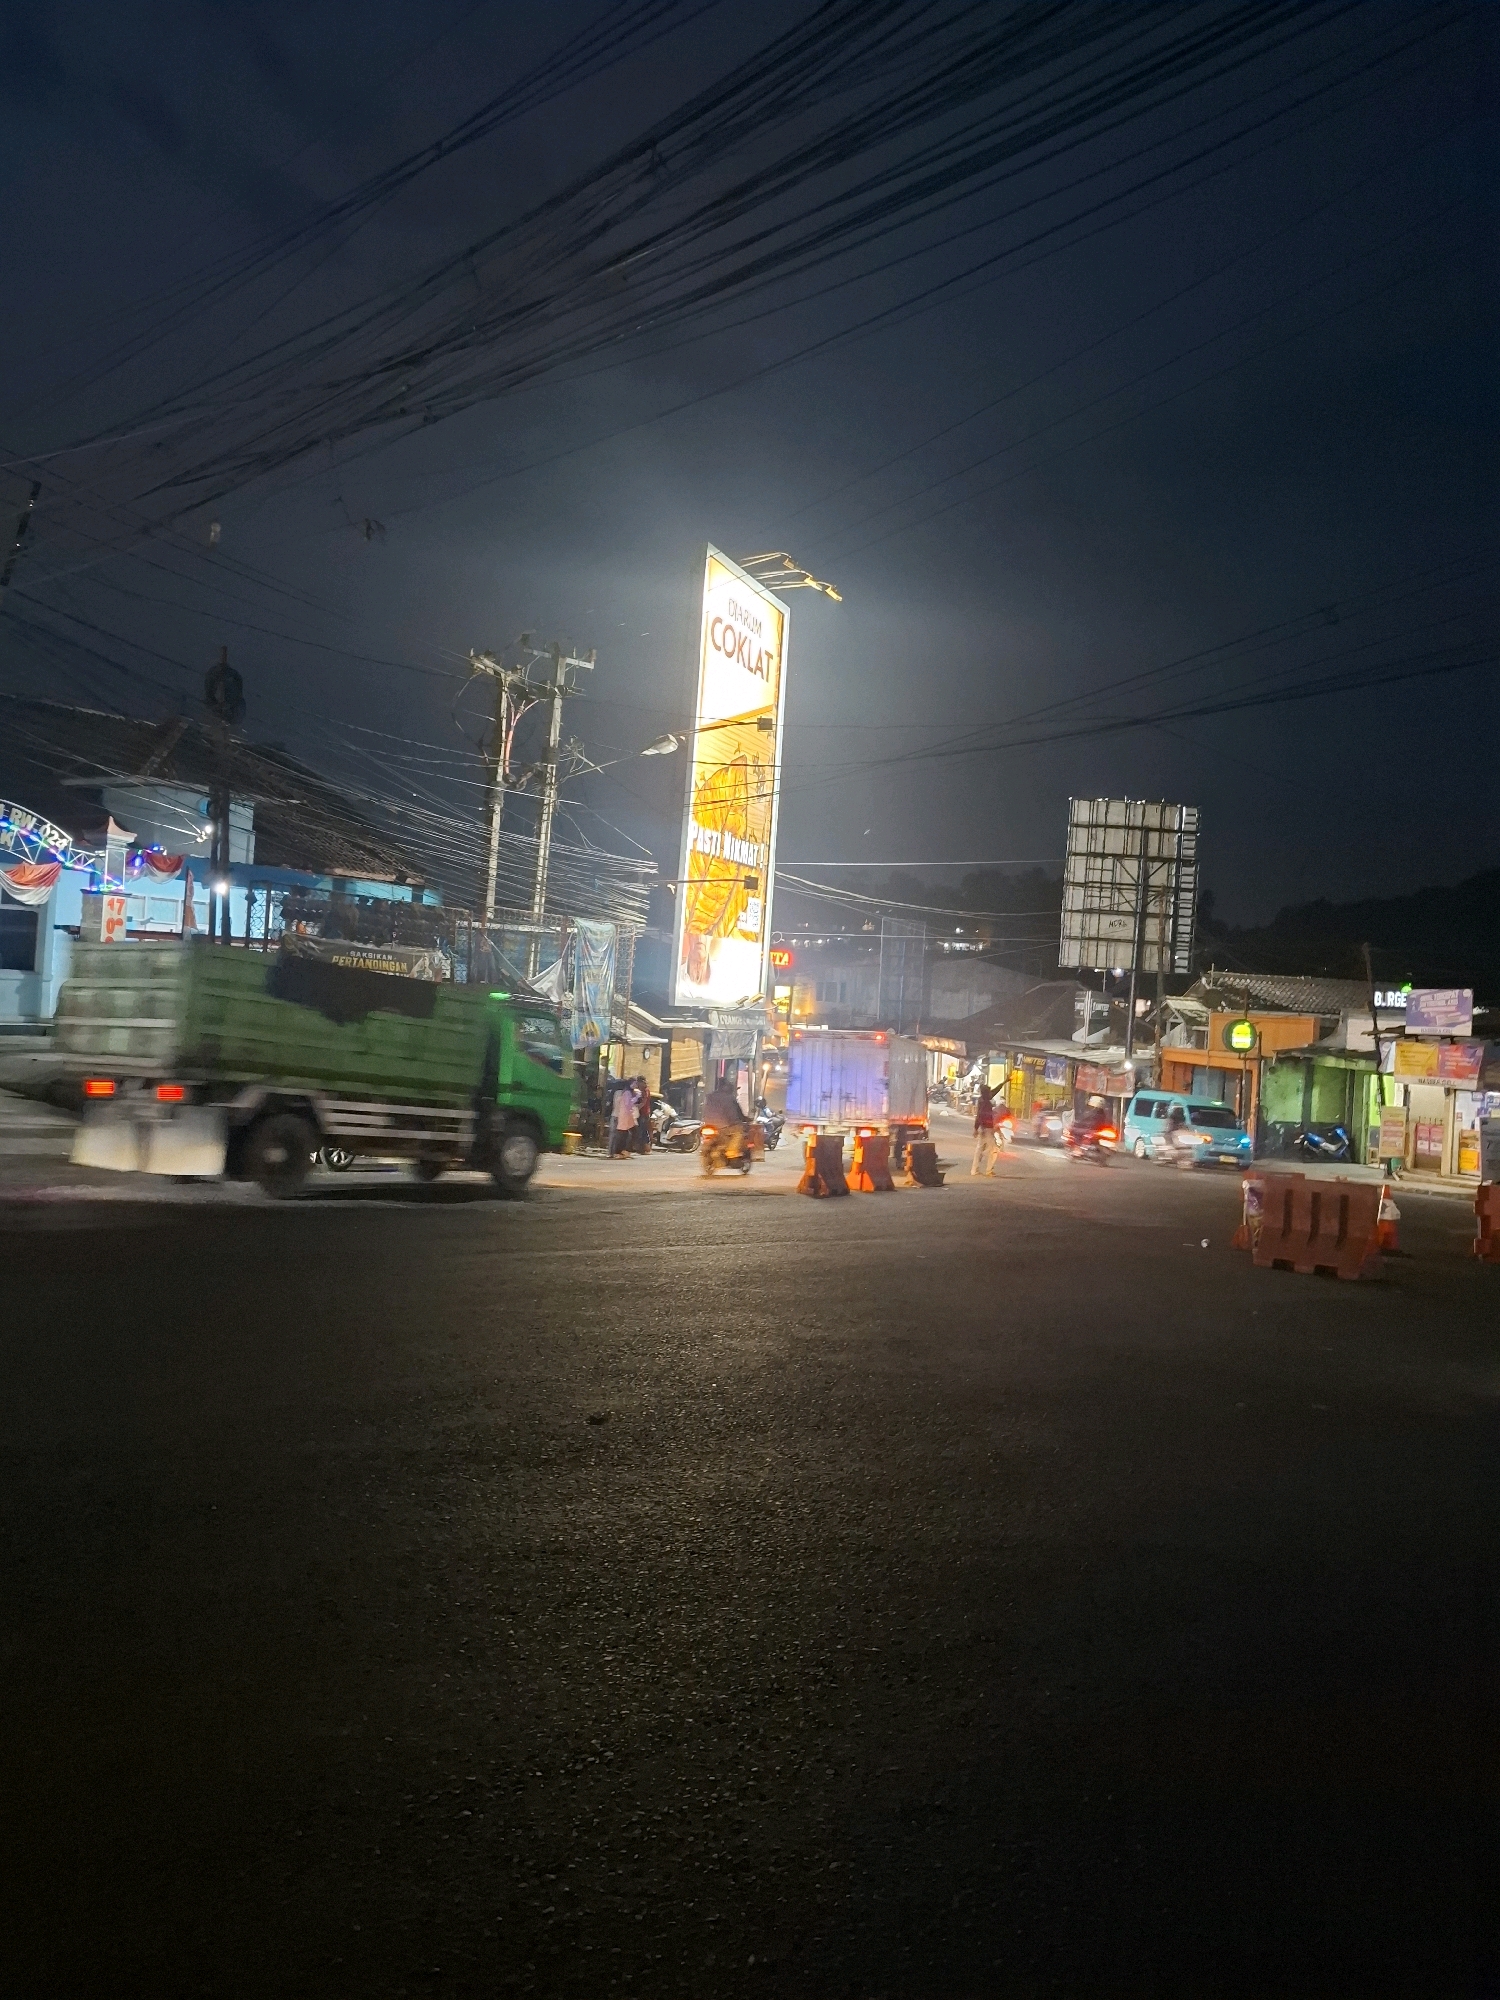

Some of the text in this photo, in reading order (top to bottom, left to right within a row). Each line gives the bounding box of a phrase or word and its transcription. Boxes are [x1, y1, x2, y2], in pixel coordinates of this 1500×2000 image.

[728, 598, 762, 638] DJARUM
[710, 616, 774, 683] COKLAT
[9, 807, 37, 831] RW
[39, 823, 68, 851] 024
[687, 823, 722, 858] PASTI
[723, 830, 759, 867] NIKMAT
[107, 897, 126, 916] 17
[331, 955, 408, 973] PERTANDINGAN
[349, 950, 393, 961] SAKSIKAN
